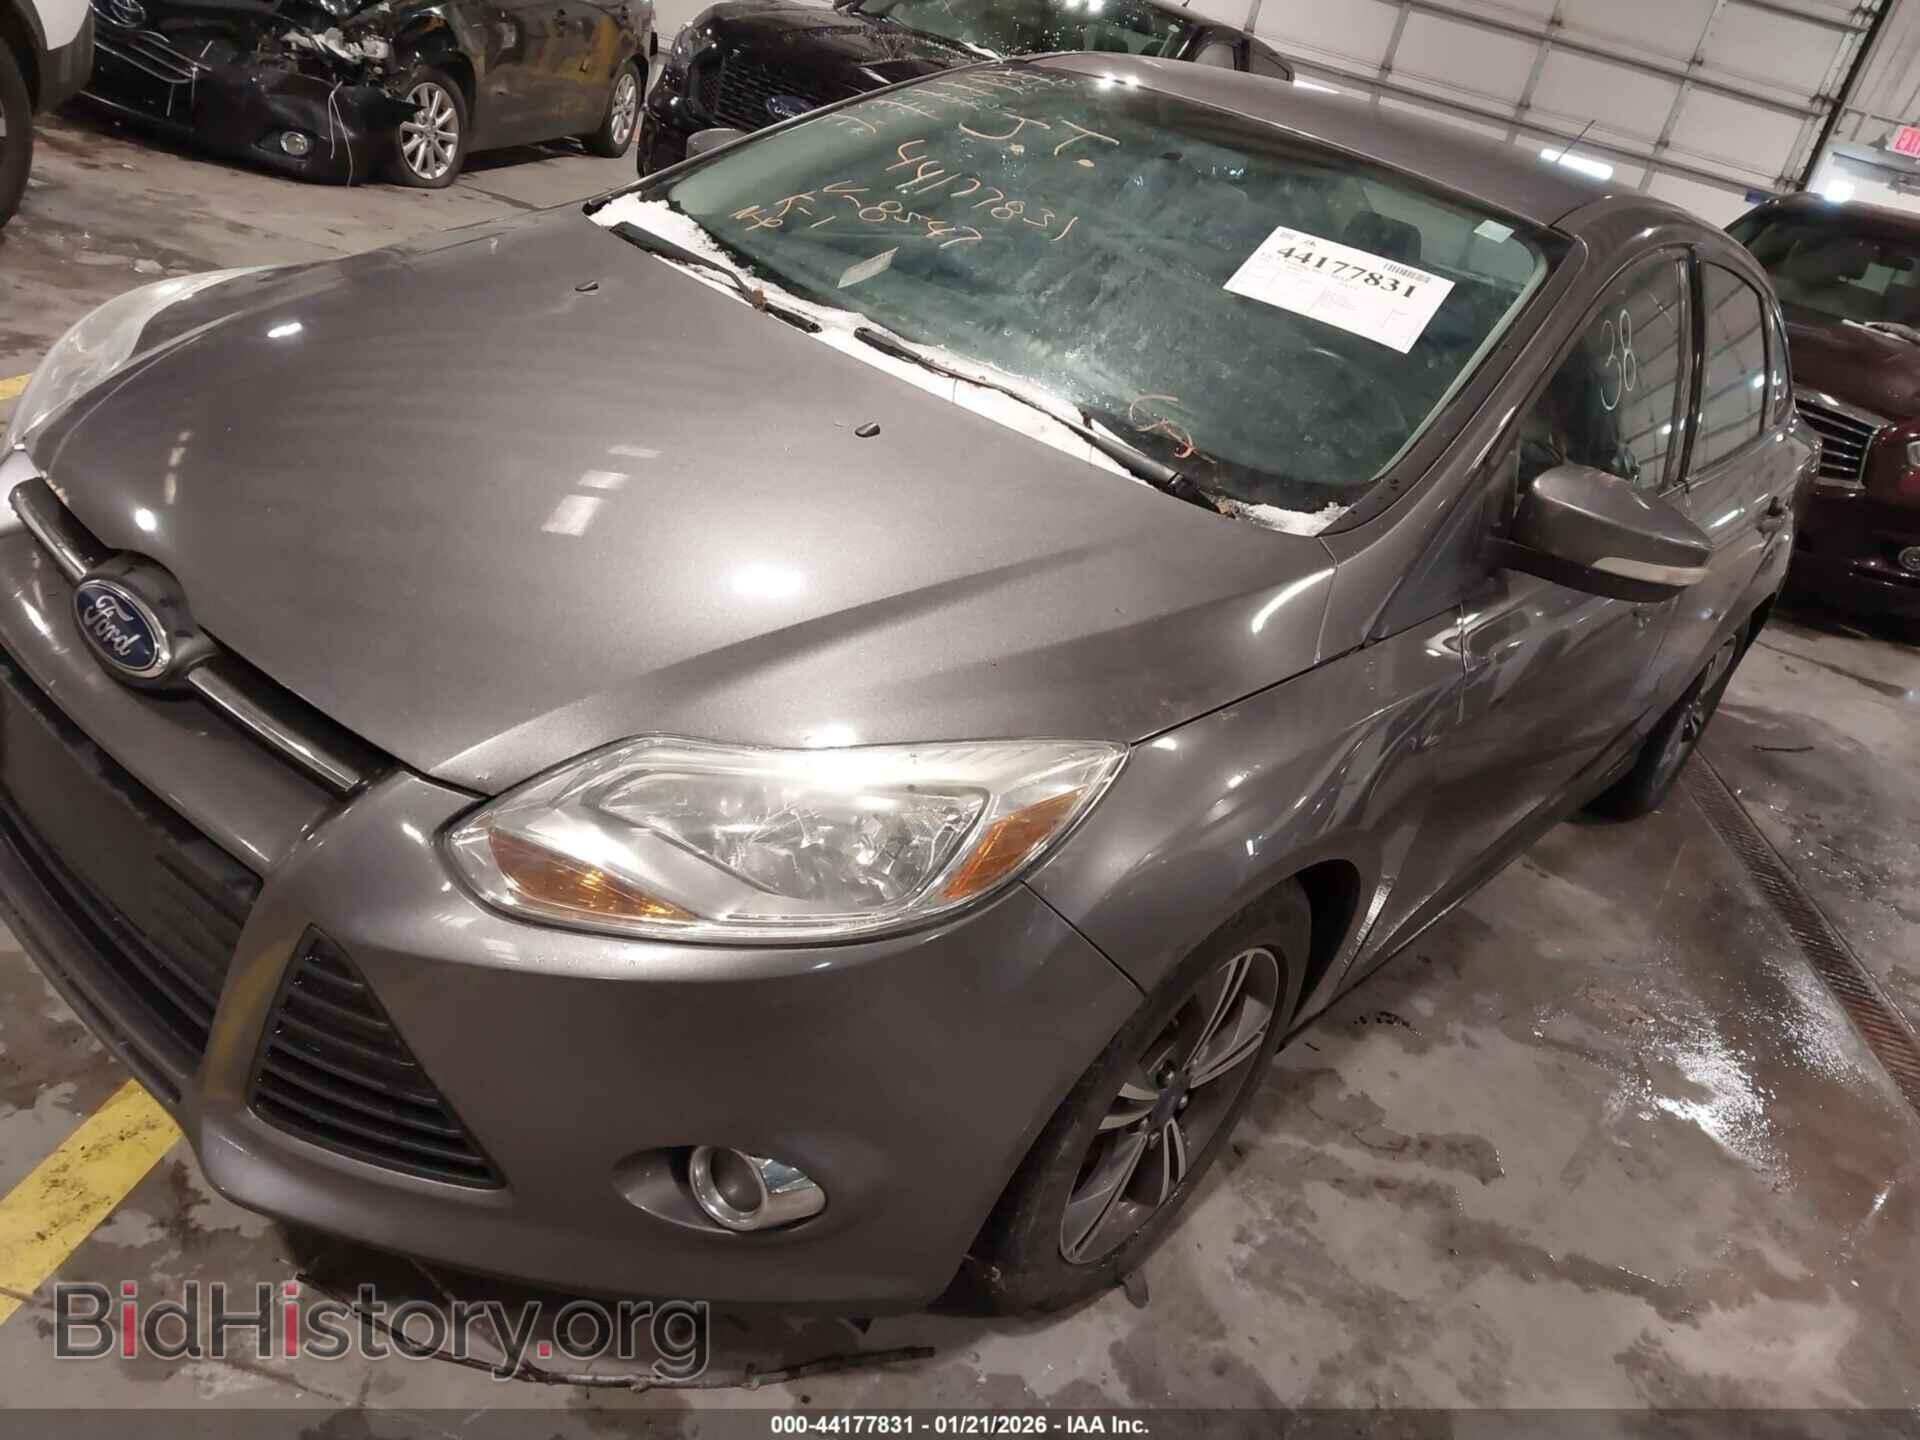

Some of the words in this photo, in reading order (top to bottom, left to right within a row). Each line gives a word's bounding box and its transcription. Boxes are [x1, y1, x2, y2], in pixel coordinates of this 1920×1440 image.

[886, 139, 1079, 242] 44177831
[1276, 246, 1417, 299] 44177831
[1600, 308, 1636, 410] 38
[83, 594, 142, 656] Ford
